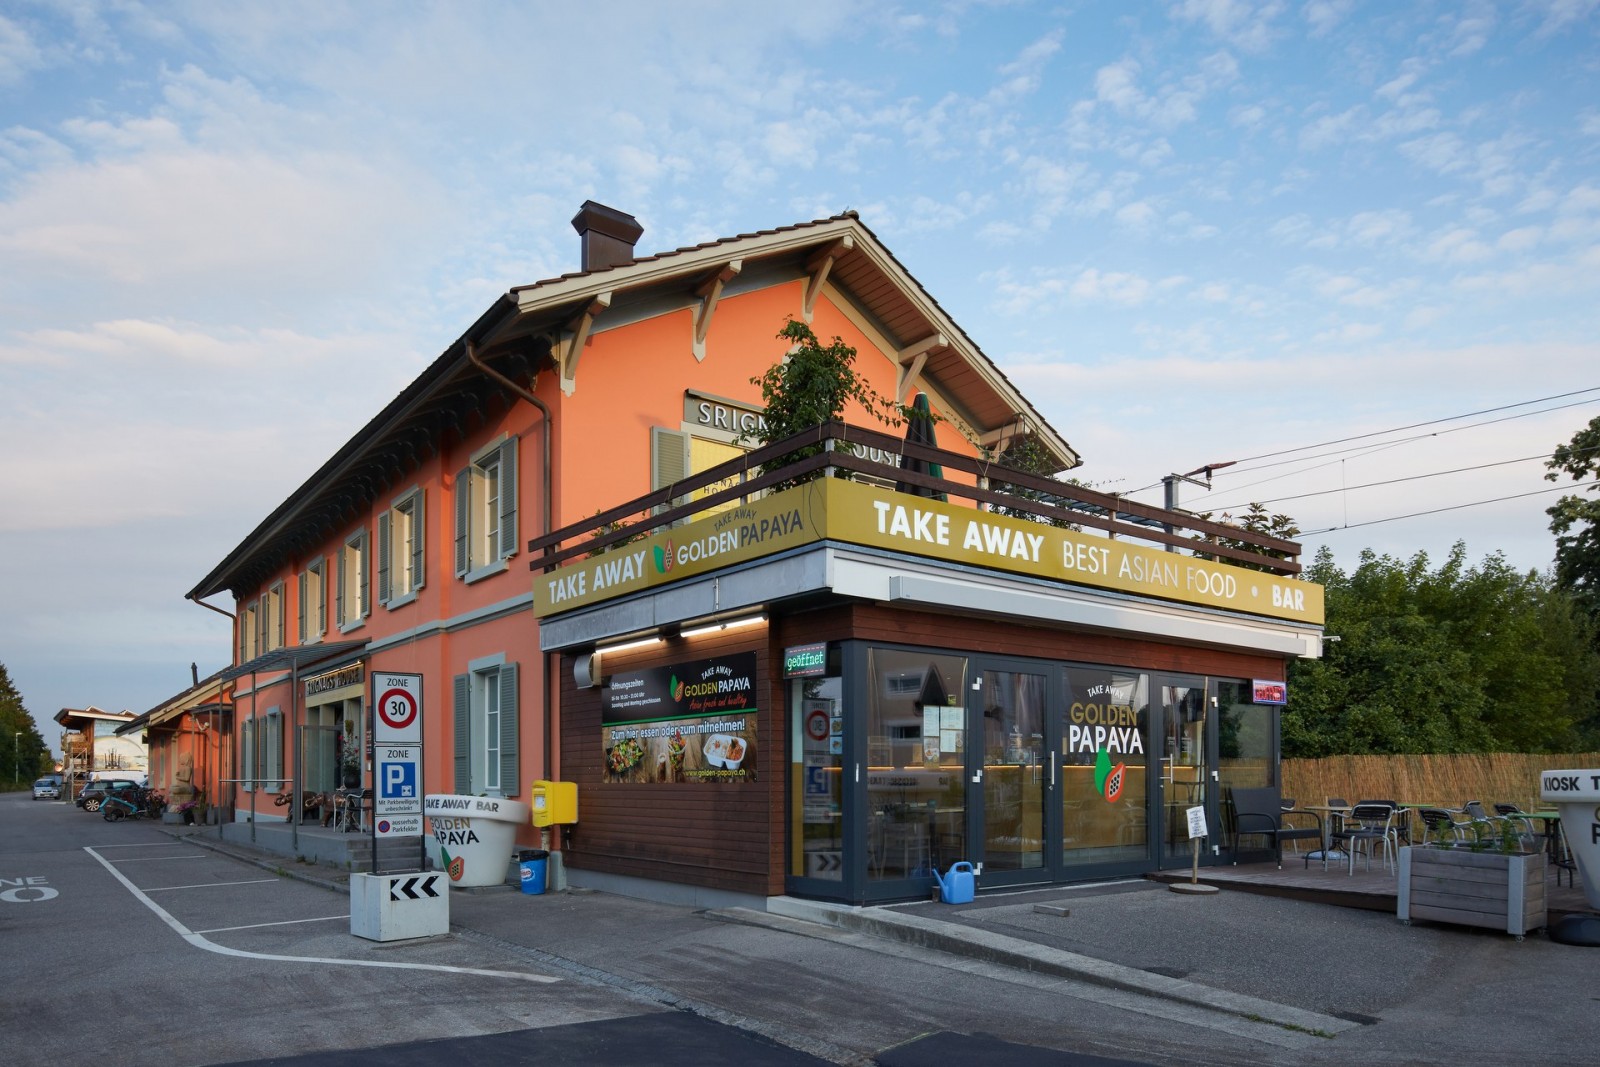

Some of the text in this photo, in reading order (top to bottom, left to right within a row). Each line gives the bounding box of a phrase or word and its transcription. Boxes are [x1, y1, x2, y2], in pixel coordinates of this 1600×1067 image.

[699, 402, 902, 469] SRIGN OUSE
[714, 508, 757, 532] TAKE AWAY
[677, 509, 804, 565] GOLDEN PAPAYA
[873, 500, 1305, 612] TAKE AWAY BEST ASIAN FOOD BAR
[549, 550, 647, 604] TAKE AWAY
[787, 651, 824, 671] geöffnet
[387, 677, 409, 688] ZONE
[701, 665, 733, 680] TAKE AWAY
[684, 676, 751, 697] GOLDEN PAPAYA
[1087, 685, 1125, 699] TAKE AWAY
[390, 701, 406, 716] 30
[1071, 702, 1137, 726] GOLDEN
[611, 729, 625, 740] Zum
[640, 728, 660, 738] essen
[661, 725, 679, 736] oder
[680, 723, 696, 735] zum
[697, 718, 745, 734] mitnehmen!
[1069, 725, 1144, 754] PAPAYA
[387, 749, 409, 758] ZONE
[387, 765, 405, 794] P
[1543, 776, 1580, 791] KIOSK
[440, 799, 471, 810] AWAY
[475, 801, 500, 812] BAR
